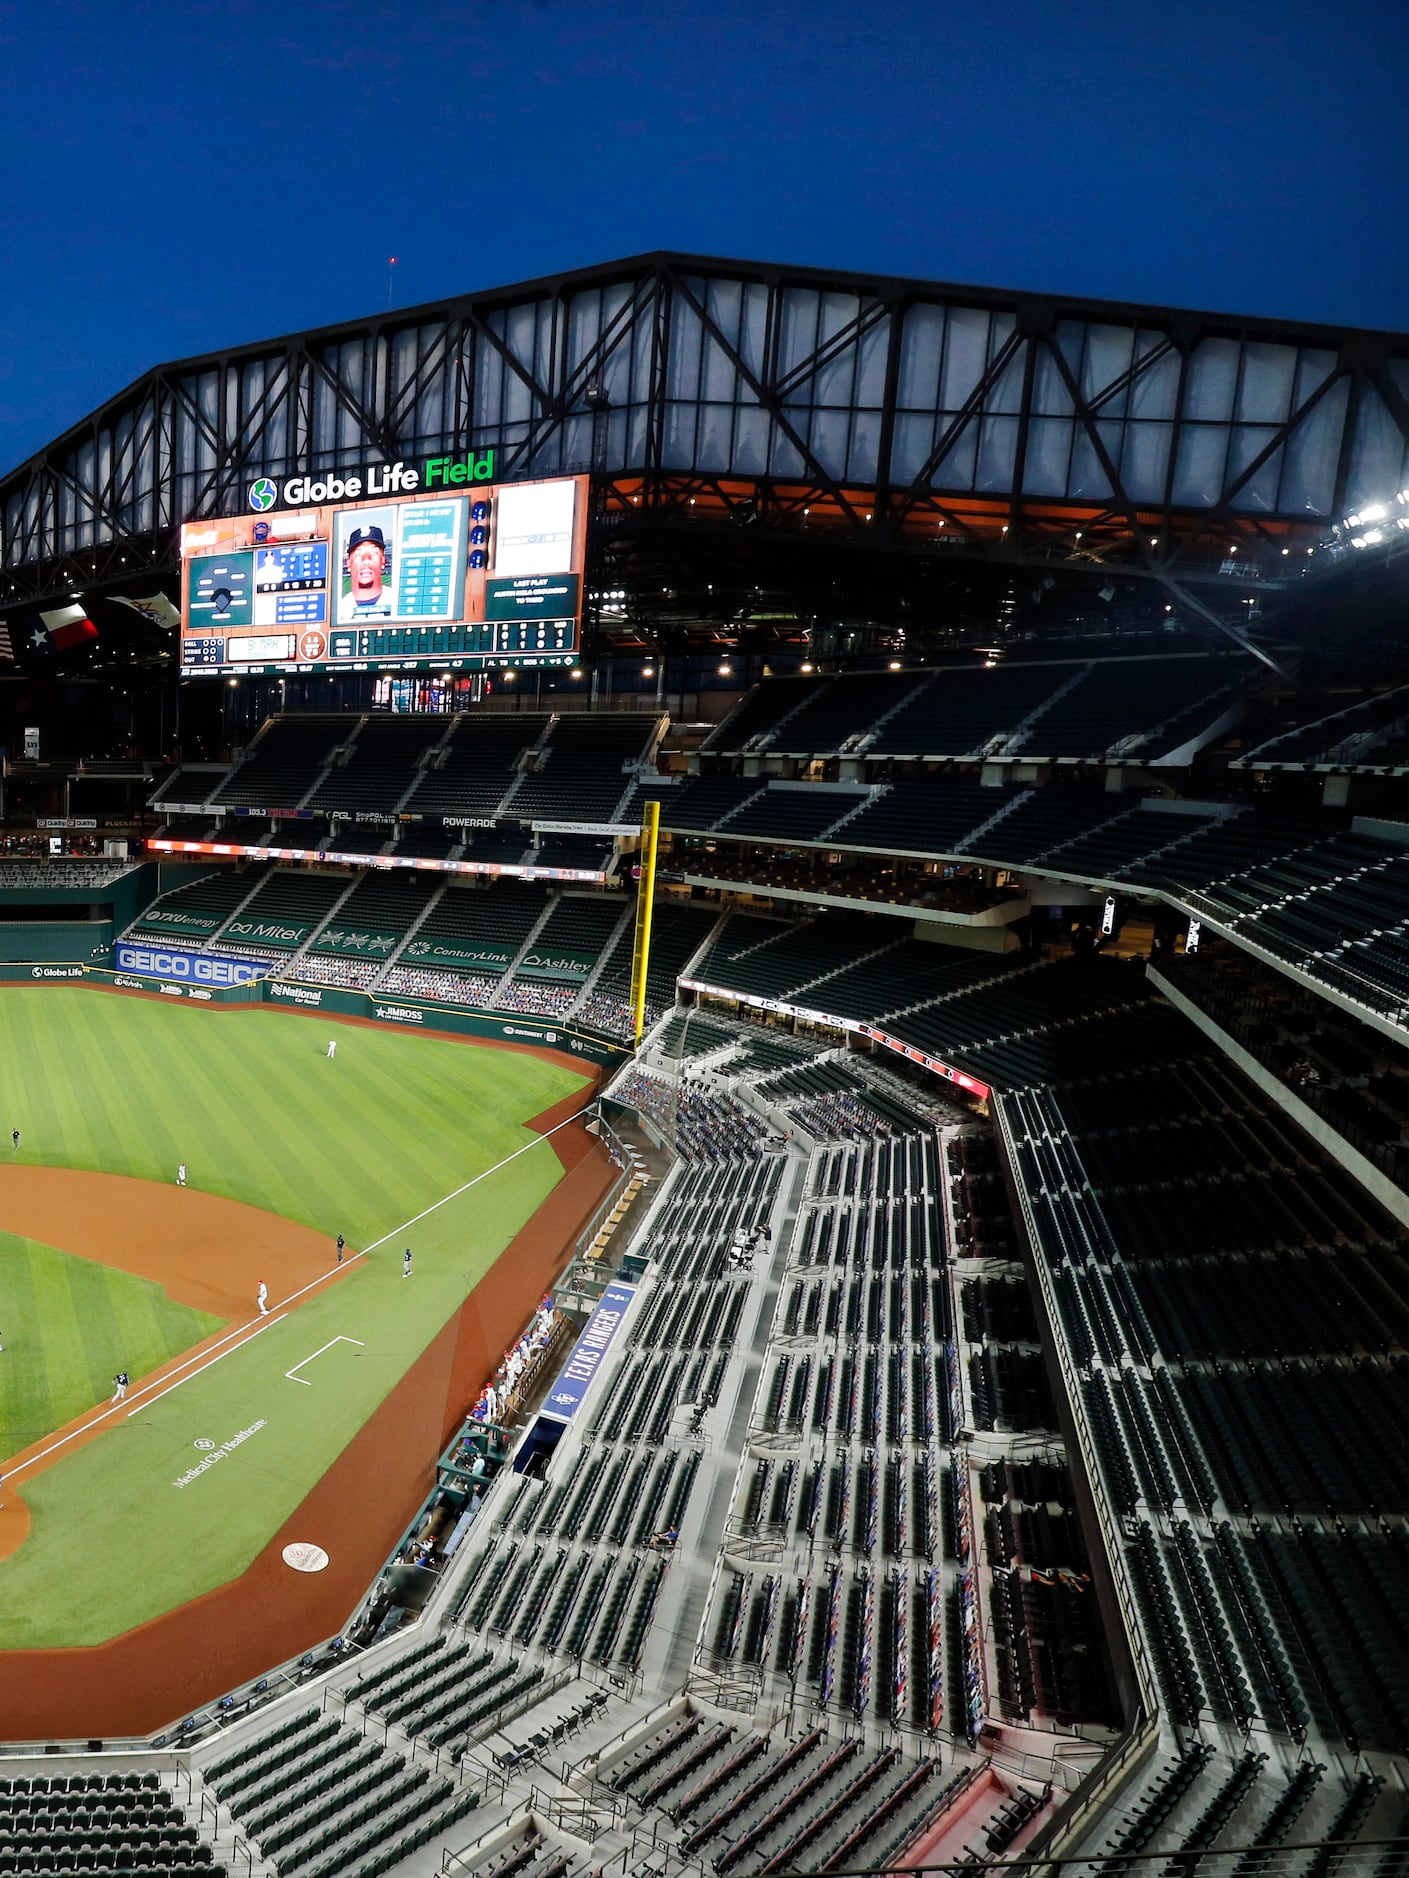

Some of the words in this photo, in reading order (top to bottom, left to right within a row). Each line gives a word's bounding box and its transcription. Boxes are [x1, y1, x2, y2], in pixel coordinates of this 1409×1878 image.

[284, 477, 361, 505] Globe
[367, 462, 419, 495] Life
[426, 450, 493, 486] Field
[538, 630, 545, 638] 0
[537, 640, 545, 648] 0
[442, 817, 496, 828] POWERADE
[252, 924, 304, 941] Mitel
[433, 946, 509, 962] CenturyLink
[119, 950, 190, 976] GEICO
[540, 957, 591, 973] Ashley
[43, 968, 67, 977] Globe
[68, 967, 83, 976] Life
[282, 986, 322, 1000] National
[582, 1308, 620, 1350] RANGERS
[564, 1348, 601, 1382] TEXAS
[172, 1460, 211, 1488] Medical
[204, 1449, 228, 1464] City
[220, 1419, 267, 1451] Healthcare
